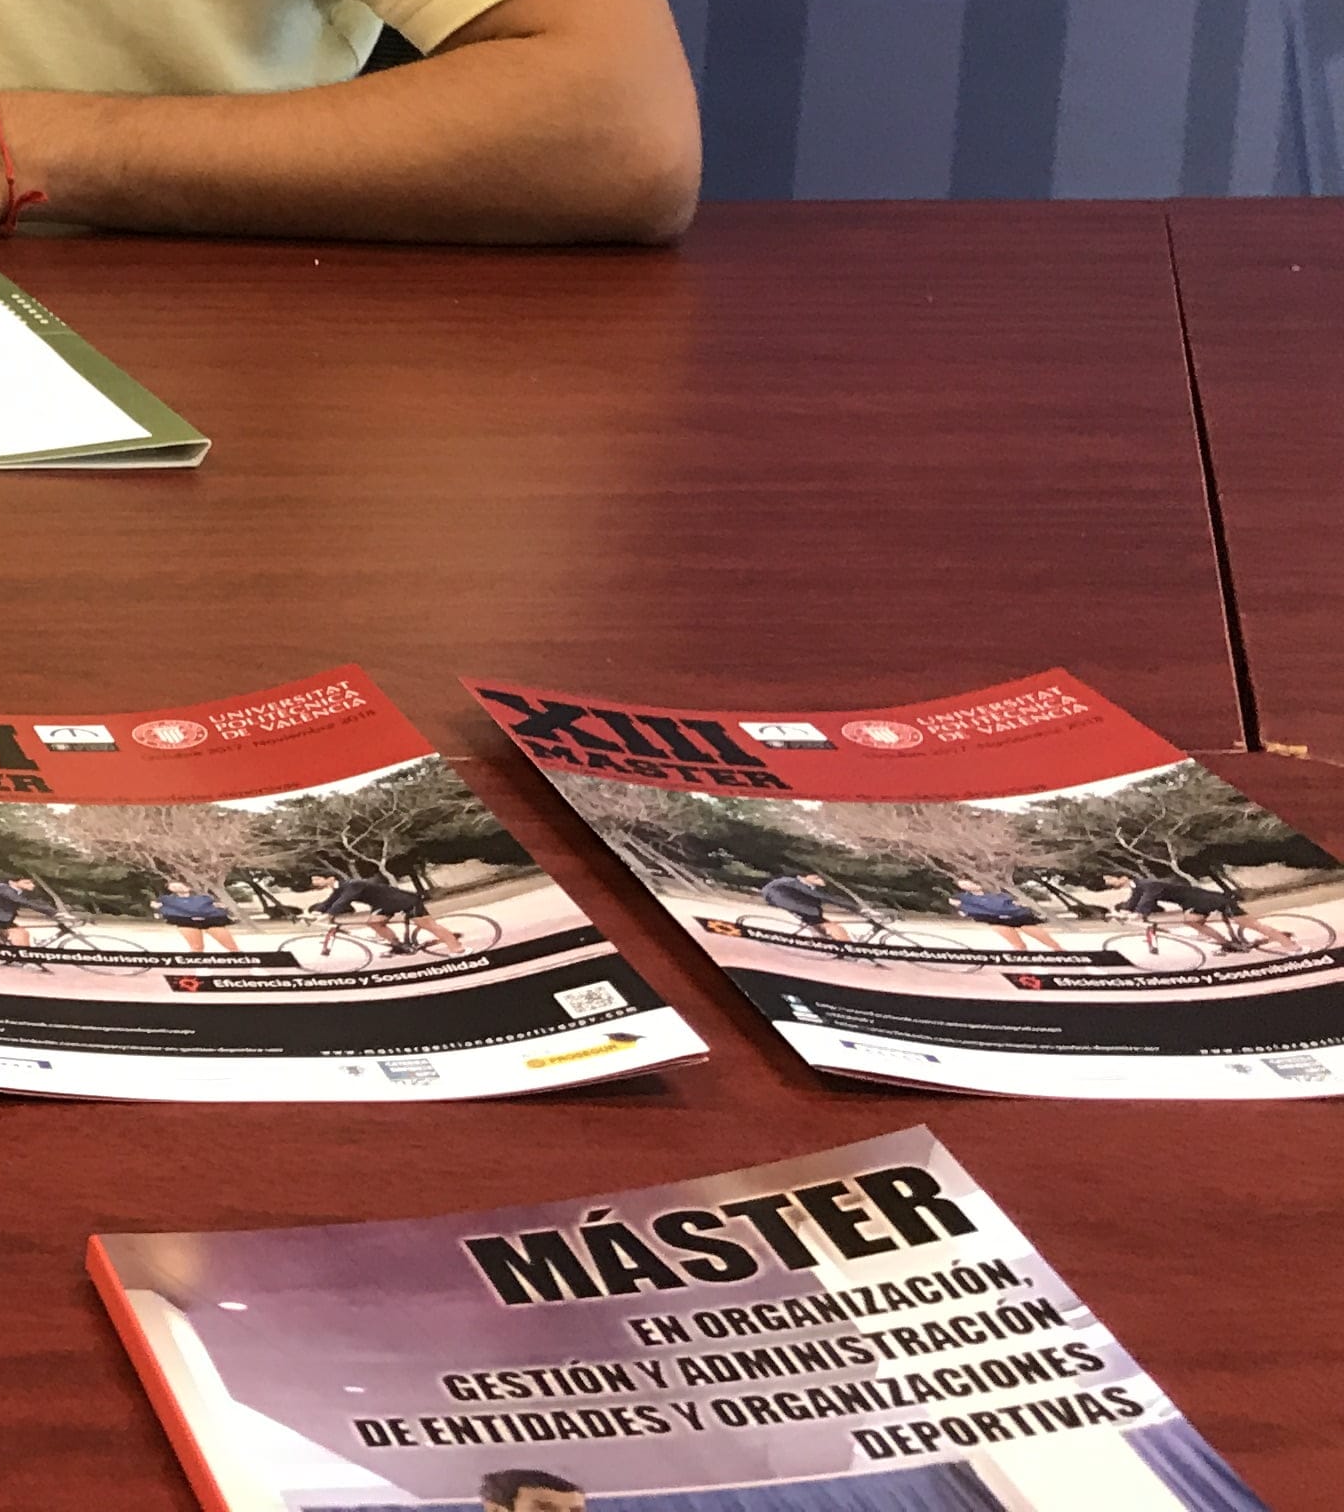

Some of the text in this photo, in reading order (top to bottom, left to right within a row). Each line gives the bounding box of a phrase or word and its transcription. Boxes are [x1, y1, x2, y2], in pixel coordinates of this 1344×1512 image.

[208, 680, 350, 723] UNIVERSITAT
[476, 688, 766, 768] XIII
[521, 738, 793, 790] MASTER
[18, 949, 159, 965] Emprededurismo
[162, 954, 173, 966] y
[175, 953, 261, 965] Excelencia
[358, 975, 370, 986] y
[372, 956, 490, 983] Sostenibilidad
[462, 1165, 979, 1305] MÁSTER
[628, 1259, 1033, 1346] EN ORGANIZACIÓN,
[443, 1297, 1067, 1402] GESTIÓN Y ADMINISTRACIÓN
[354, 1341, 1105, 1447] DE ENTIDADES Y ORGANIZACIONES
[851, 1385, 1145, 1462] DEPORTIVAS
